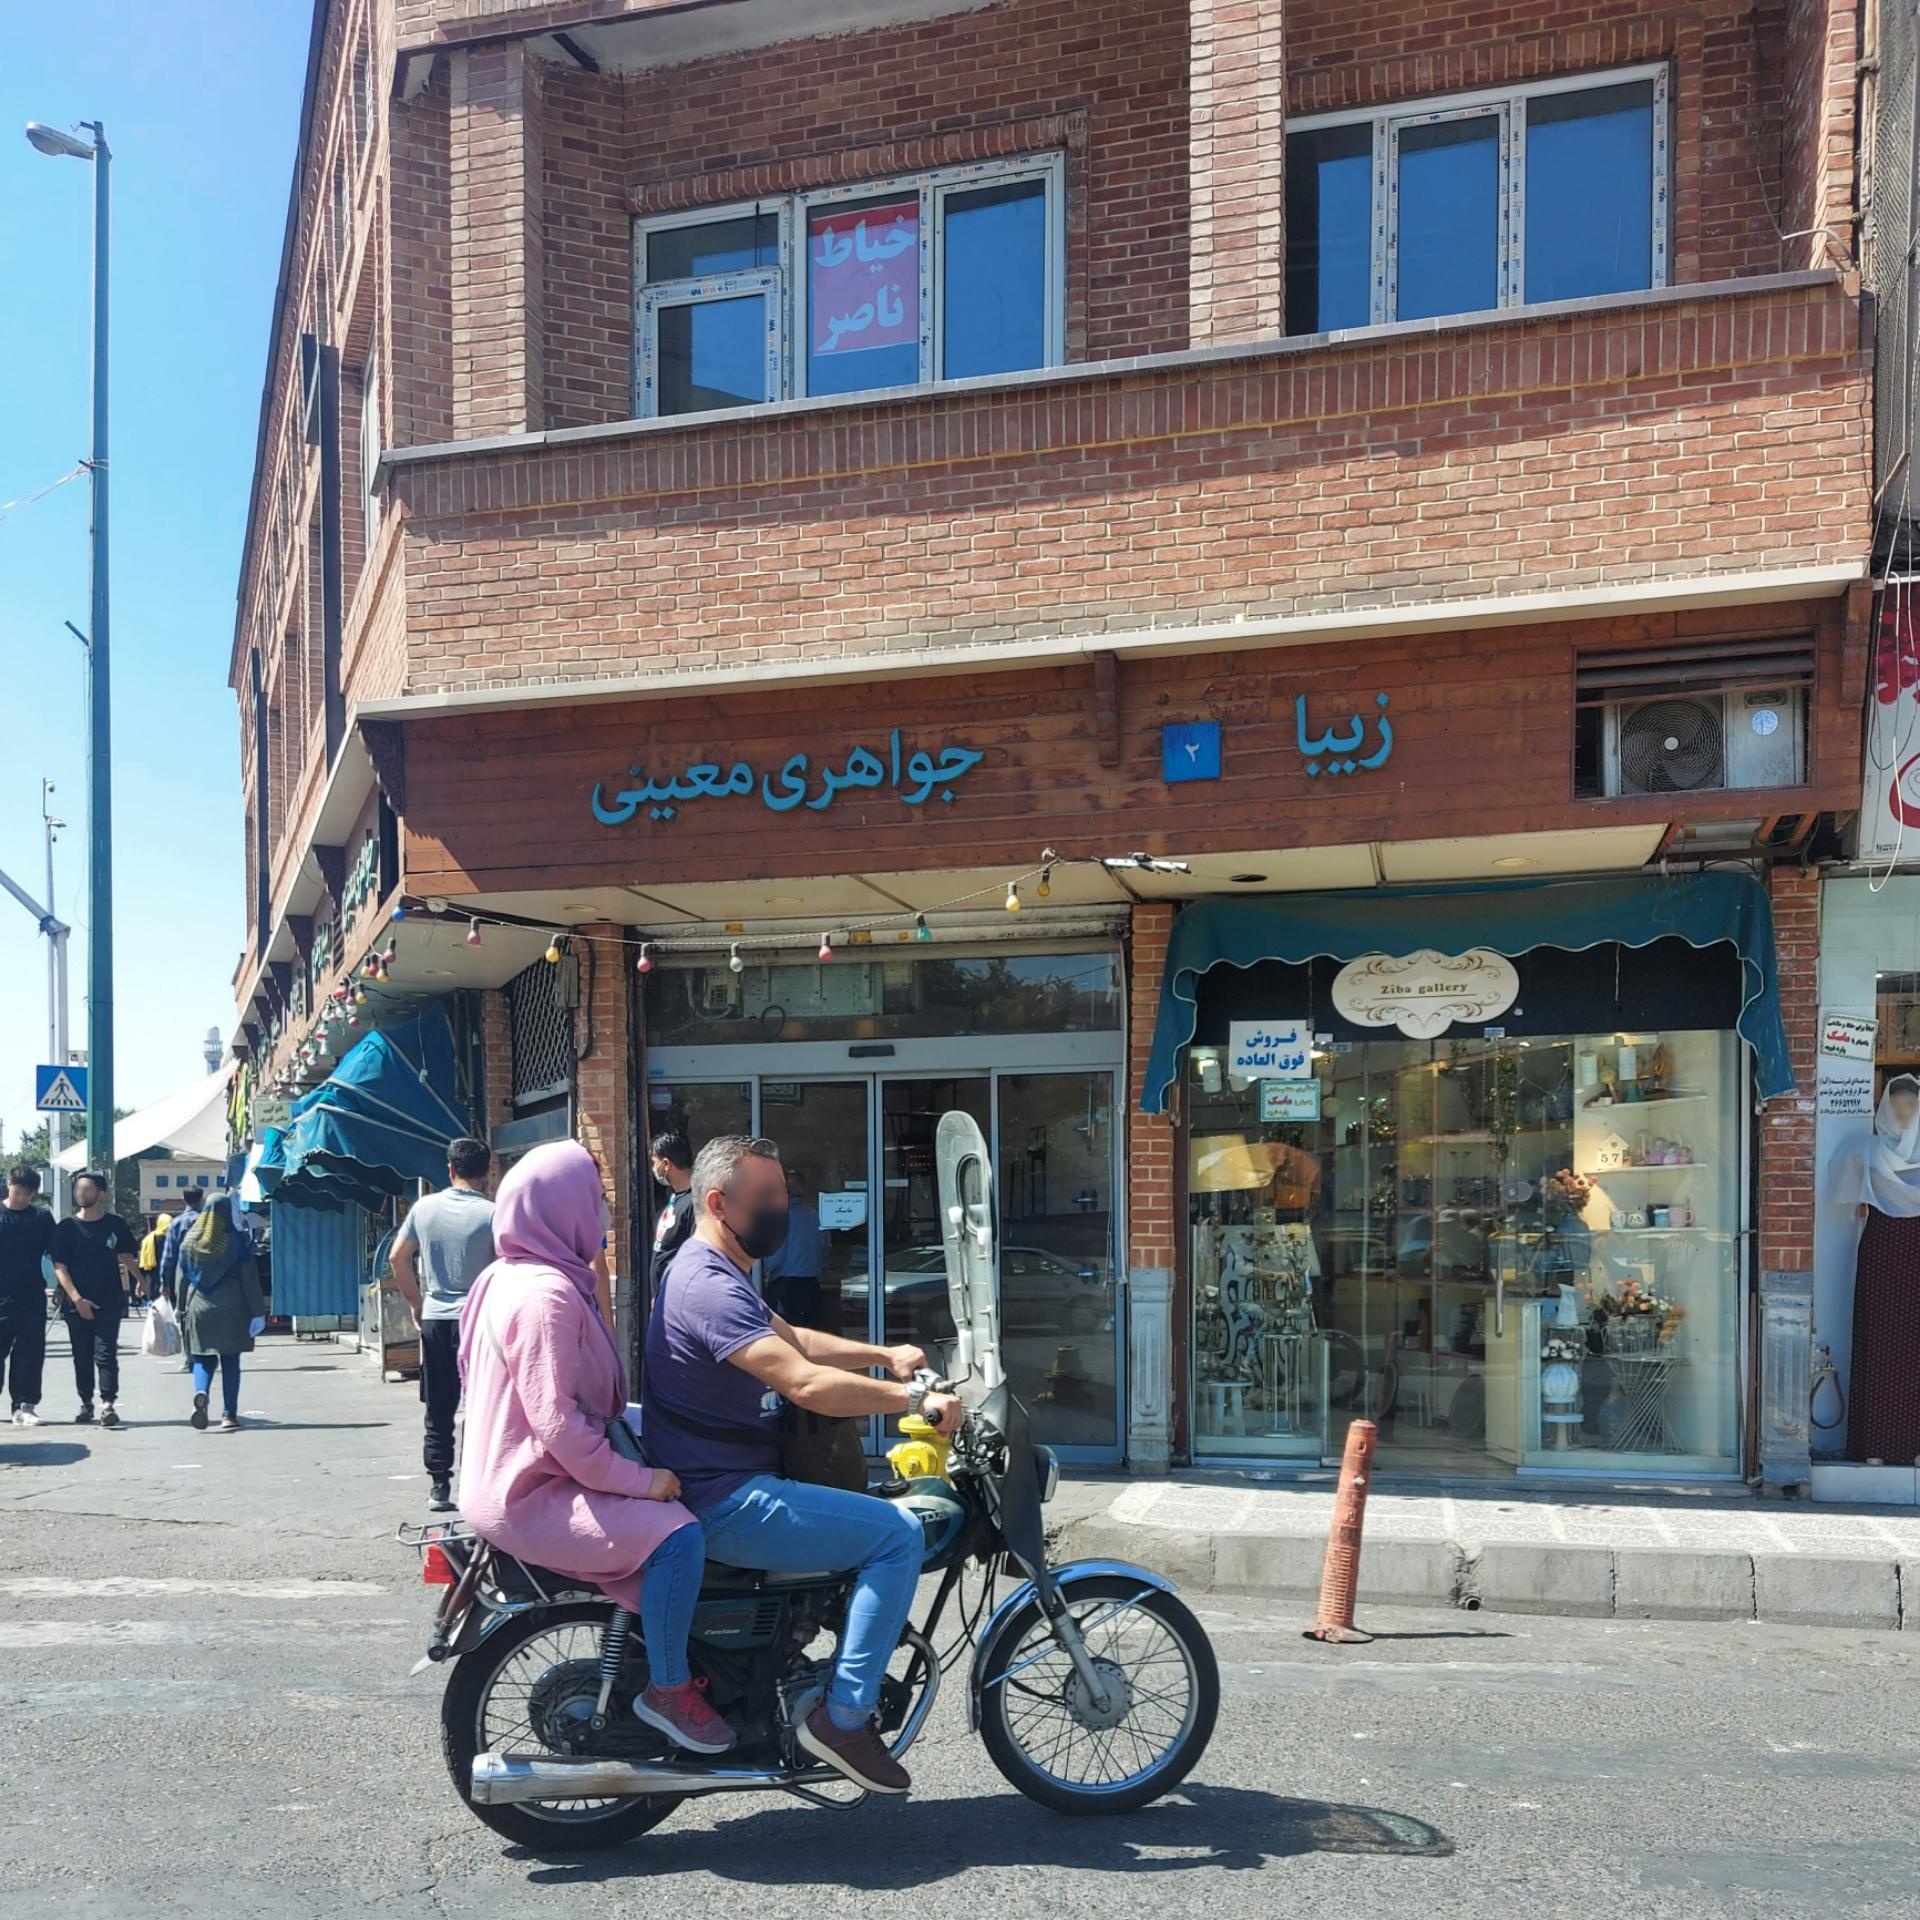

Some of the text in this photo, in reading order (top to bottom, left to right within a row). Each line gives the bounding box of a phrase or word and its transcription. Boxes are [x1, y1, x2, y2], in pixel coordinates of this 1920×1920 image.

[814, 212, 918, 274] خیاط
[817, 285, 905, 351] ناصر
[1296, 692, 1394, 776] زیبا
[591, 728, 984, 826] جواهری معینی
[1380, 983, 1469, 995] Ziba gallery
[1246, 1028, 1297, 1048] فروش
[1826, 1030, 1851, 1043] ماسک
[1236, 1051, 1305, 1070] فوق العاده
